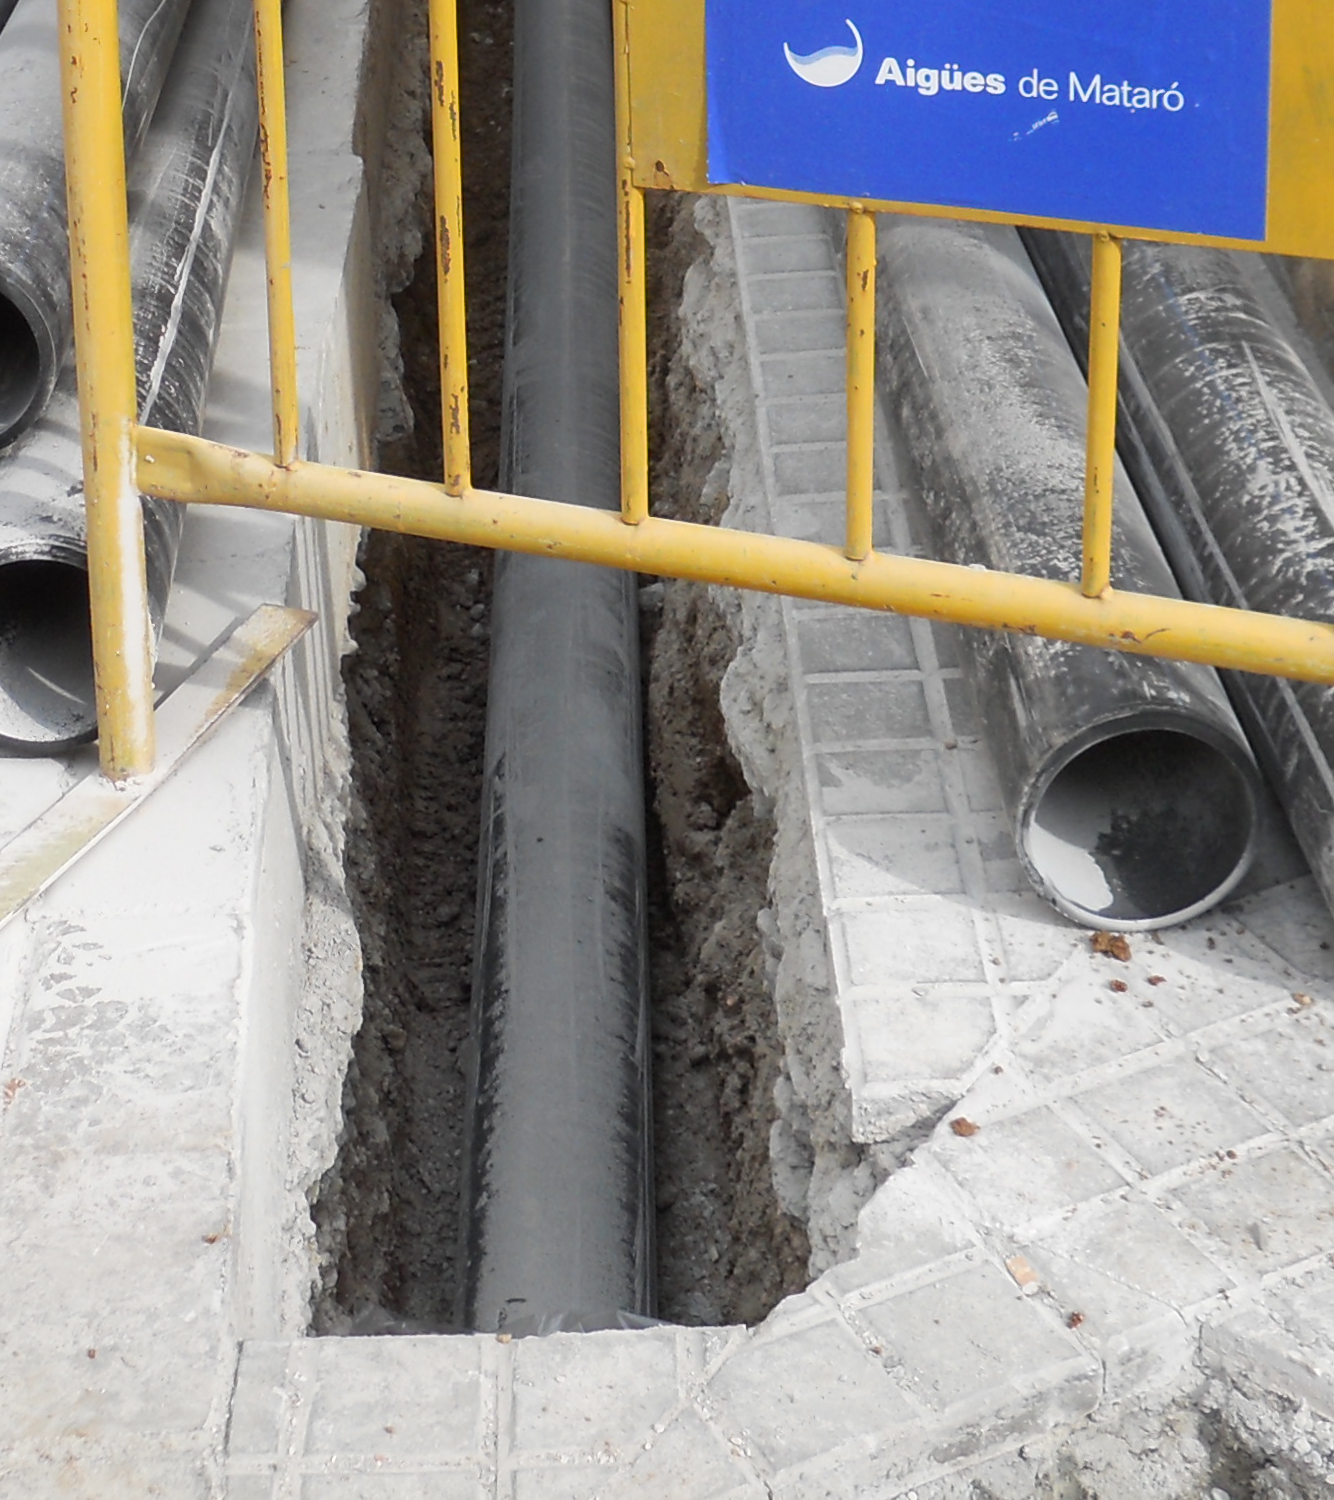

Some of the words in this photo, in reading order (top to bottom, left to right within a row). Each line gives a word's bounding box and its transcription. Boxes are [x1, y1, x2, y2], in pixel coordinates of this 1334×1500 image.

[874, 56, 1006, 96] Aigües
[1018, 67, 1059, 100] de
[1068, 71, 1185, 112] Mataró
